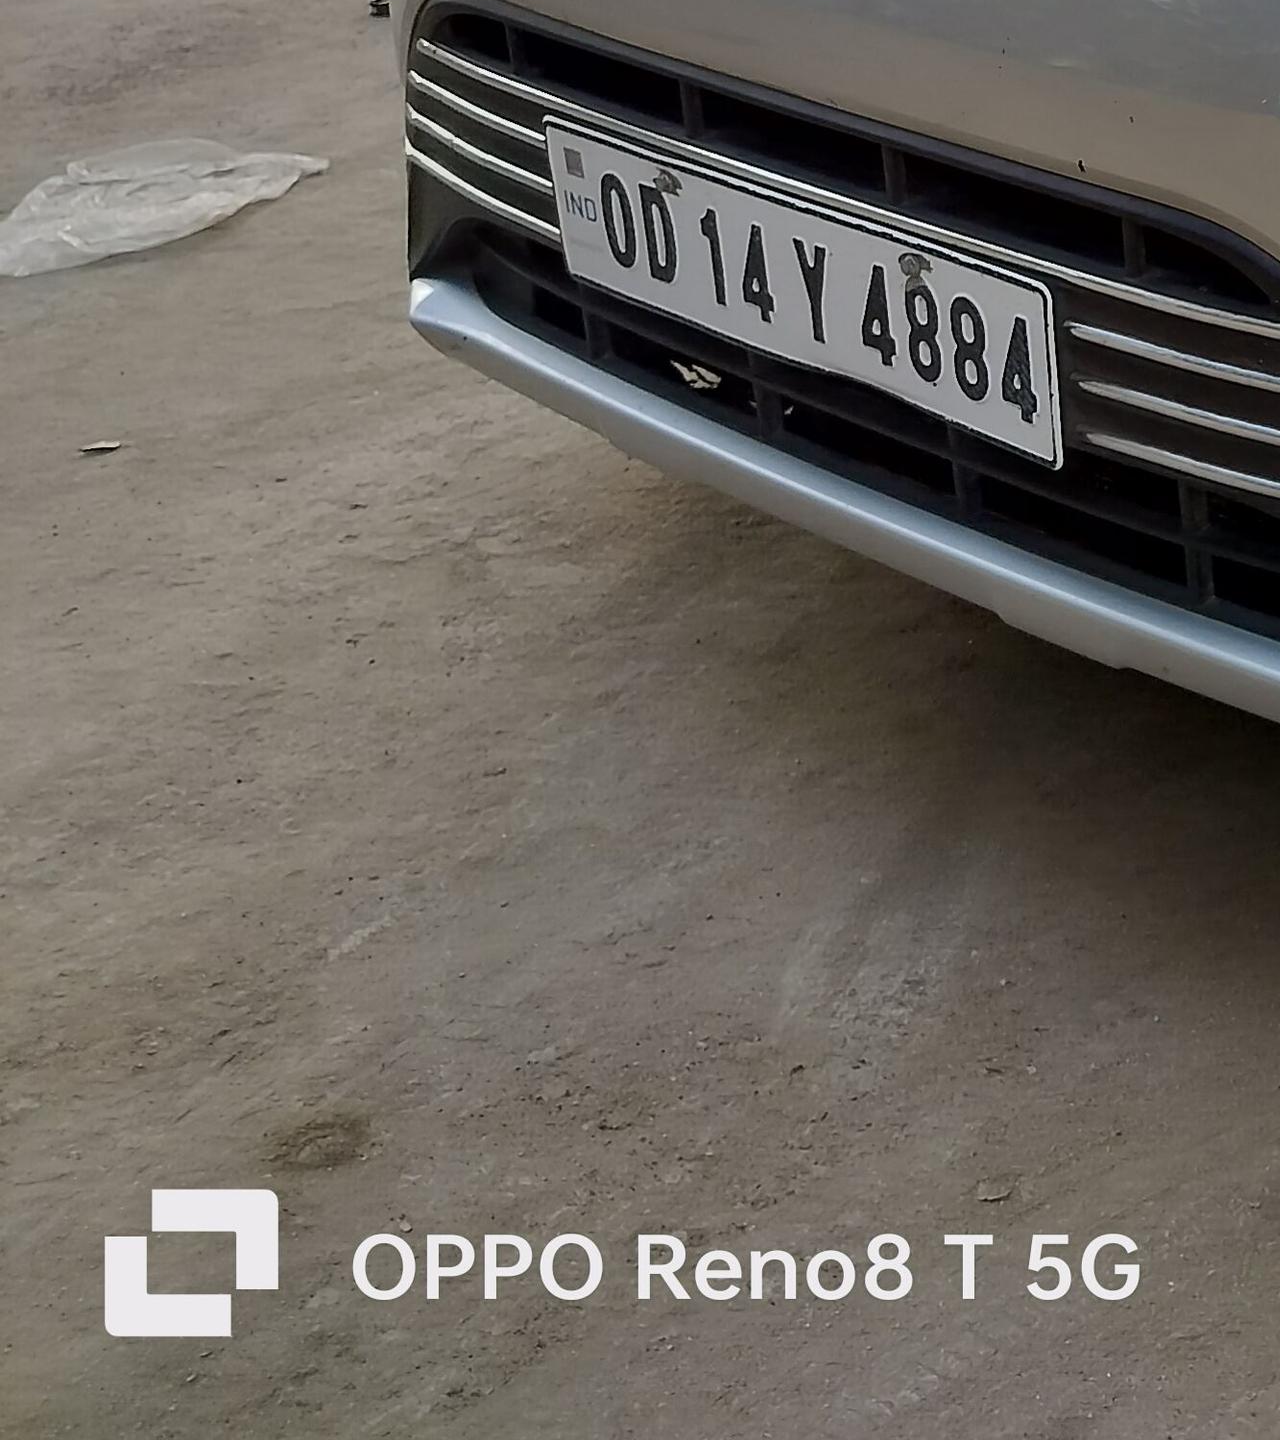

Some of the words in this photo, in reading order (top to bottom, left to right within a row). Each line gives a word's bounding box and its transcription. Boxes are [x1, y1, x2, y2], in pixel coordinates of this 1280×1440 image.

[564, 189, 597, 222] IND
[600, 172, 677, 283] OD
[700, 208, 775, 324] 14
[793, 237, 826, 344] Y
[861, 264, 1038, 424] 4884
